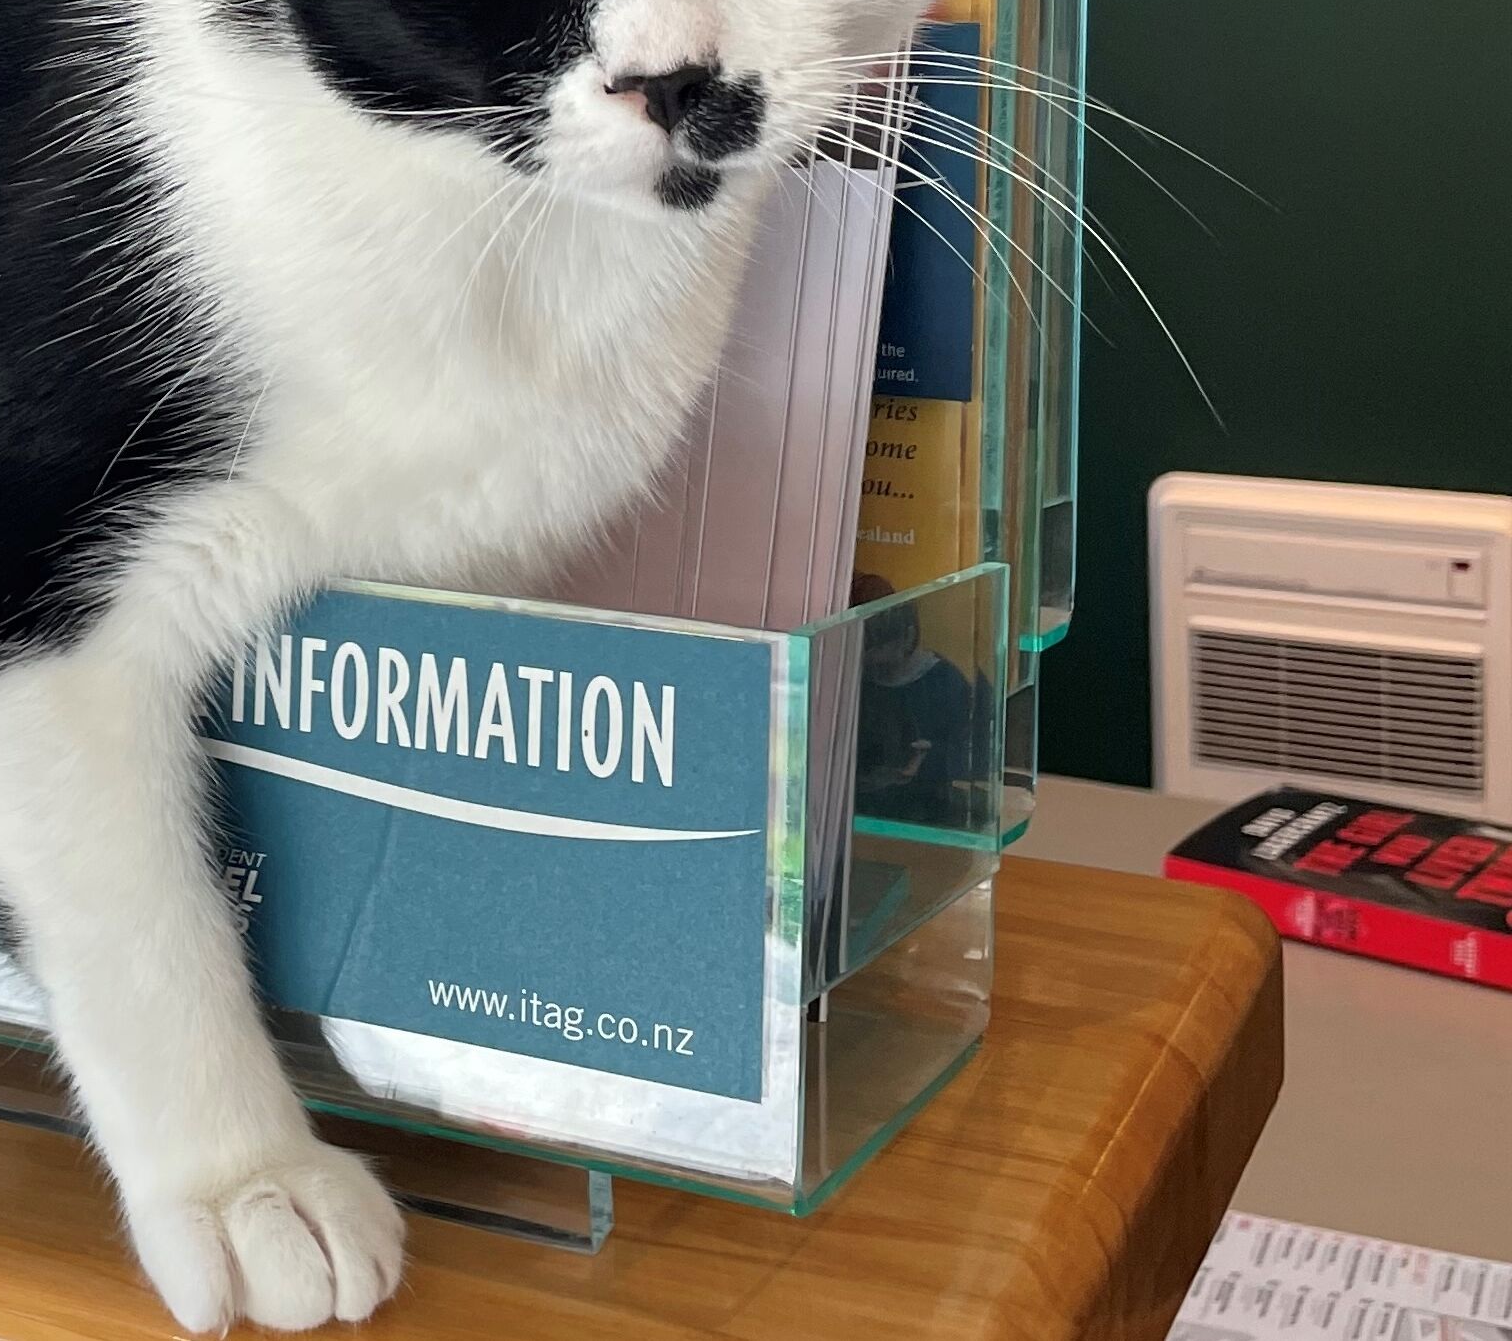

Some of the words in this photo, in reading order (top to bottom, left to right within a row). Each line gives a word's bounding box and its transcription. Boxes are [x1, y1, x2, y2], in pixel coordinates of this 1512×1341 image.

[881, 343, 906, 358] the
[231, 634, 677, 788] INFORMATION
[427, 978, 695, 1057] www.itag.co.nz
